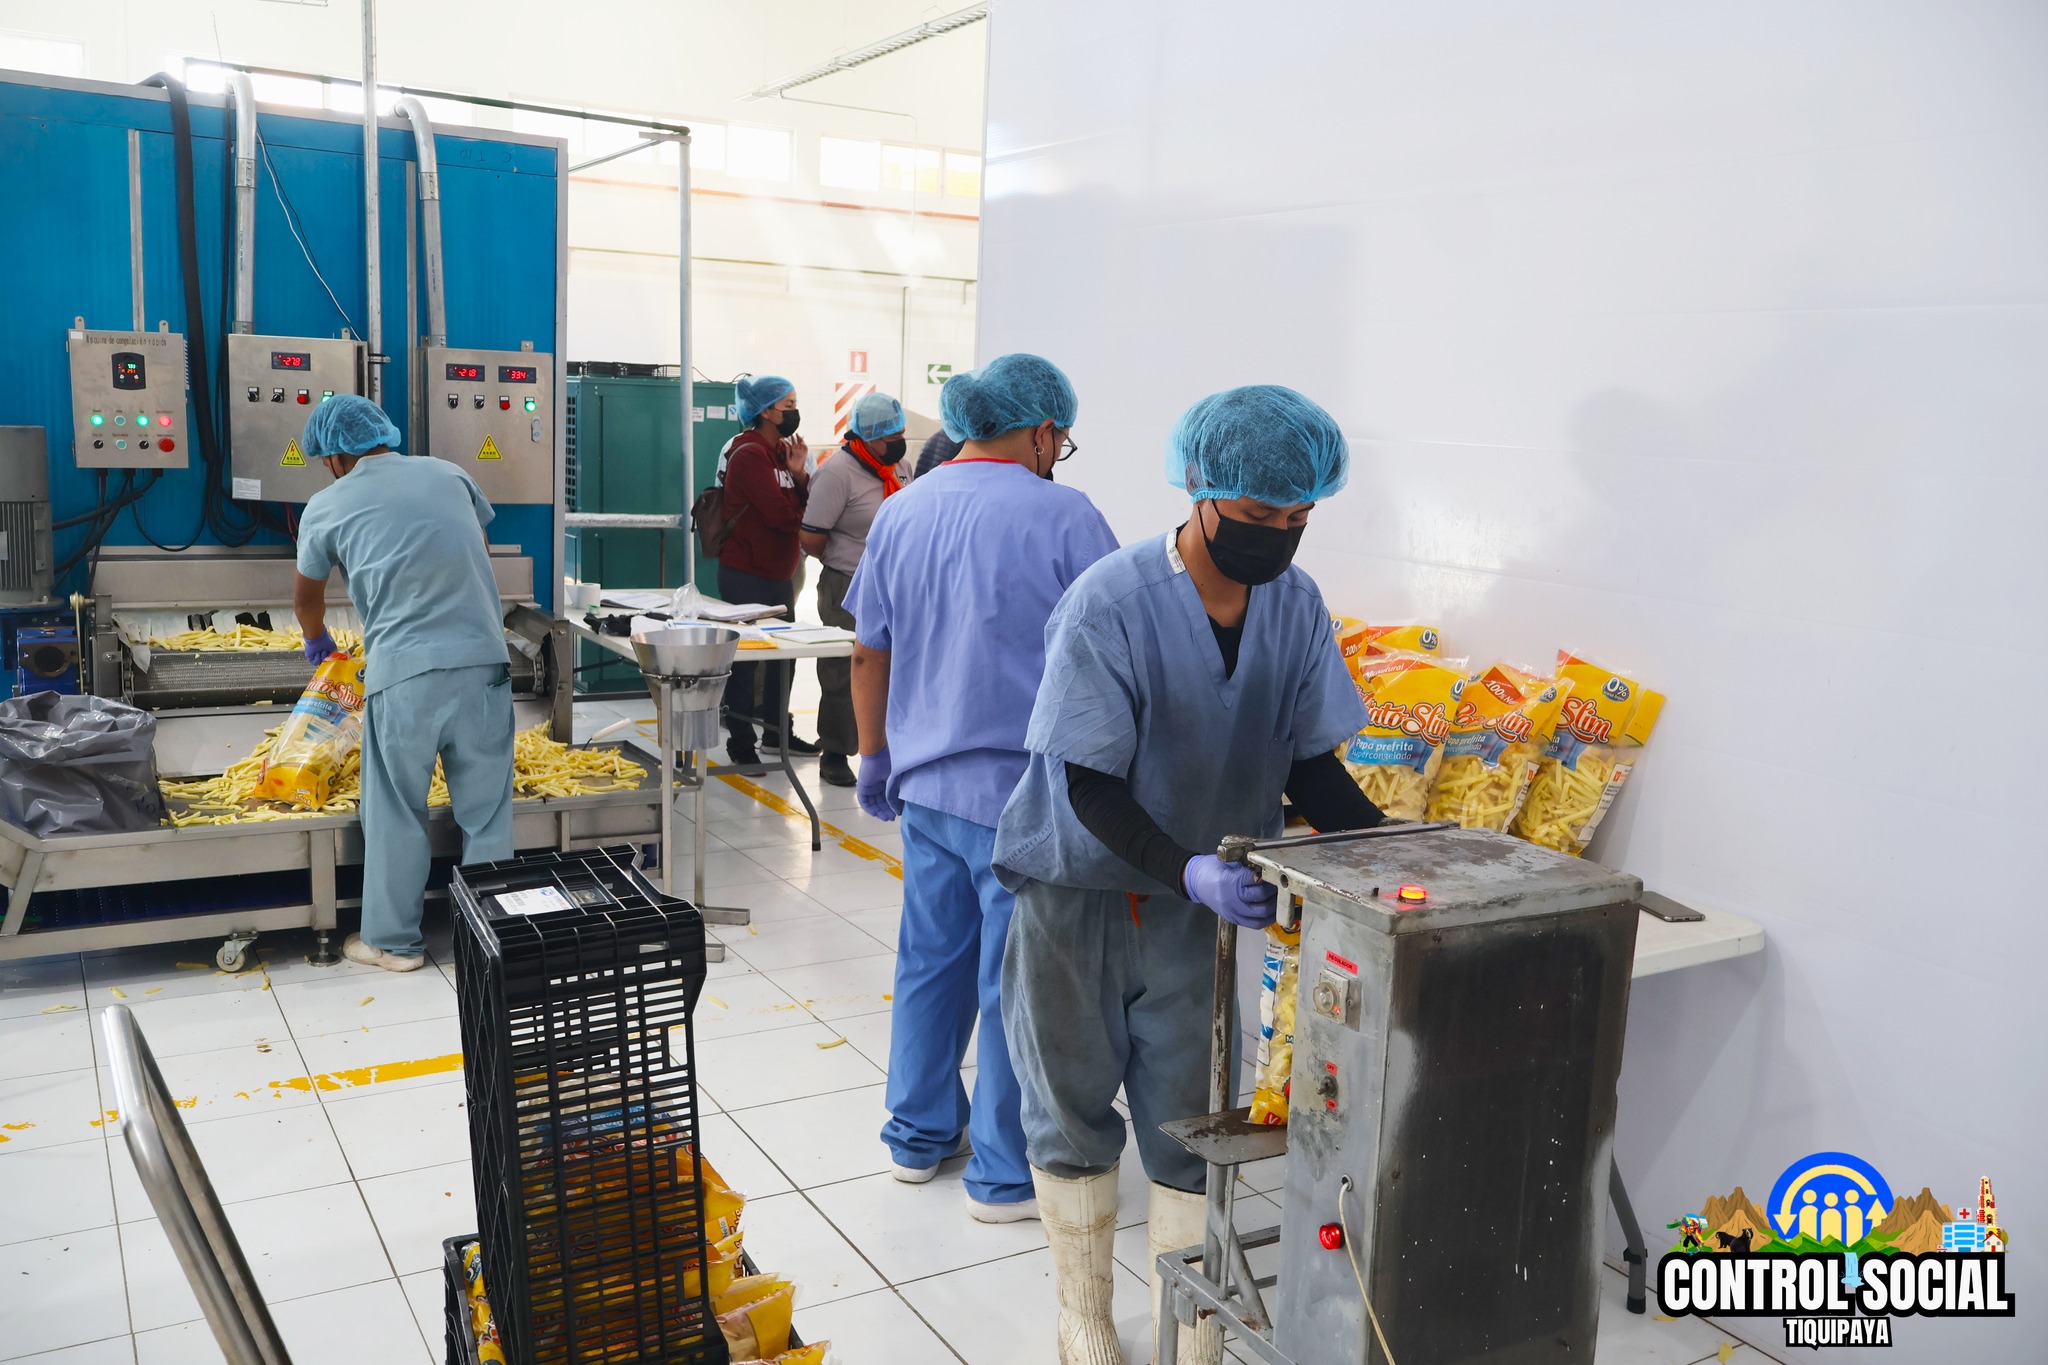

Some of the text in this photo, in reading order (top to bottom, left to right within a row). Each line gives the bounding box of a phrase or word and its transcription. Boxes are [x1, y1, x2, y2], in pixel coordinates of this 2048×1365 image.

[1606, 676, 1627, 698] 0%
[1556, 697, 1613, 744] Slim
[1355, 738, 1414, 753] Papa prefrita
[1351, 749, 1412, 761] supercongelada
